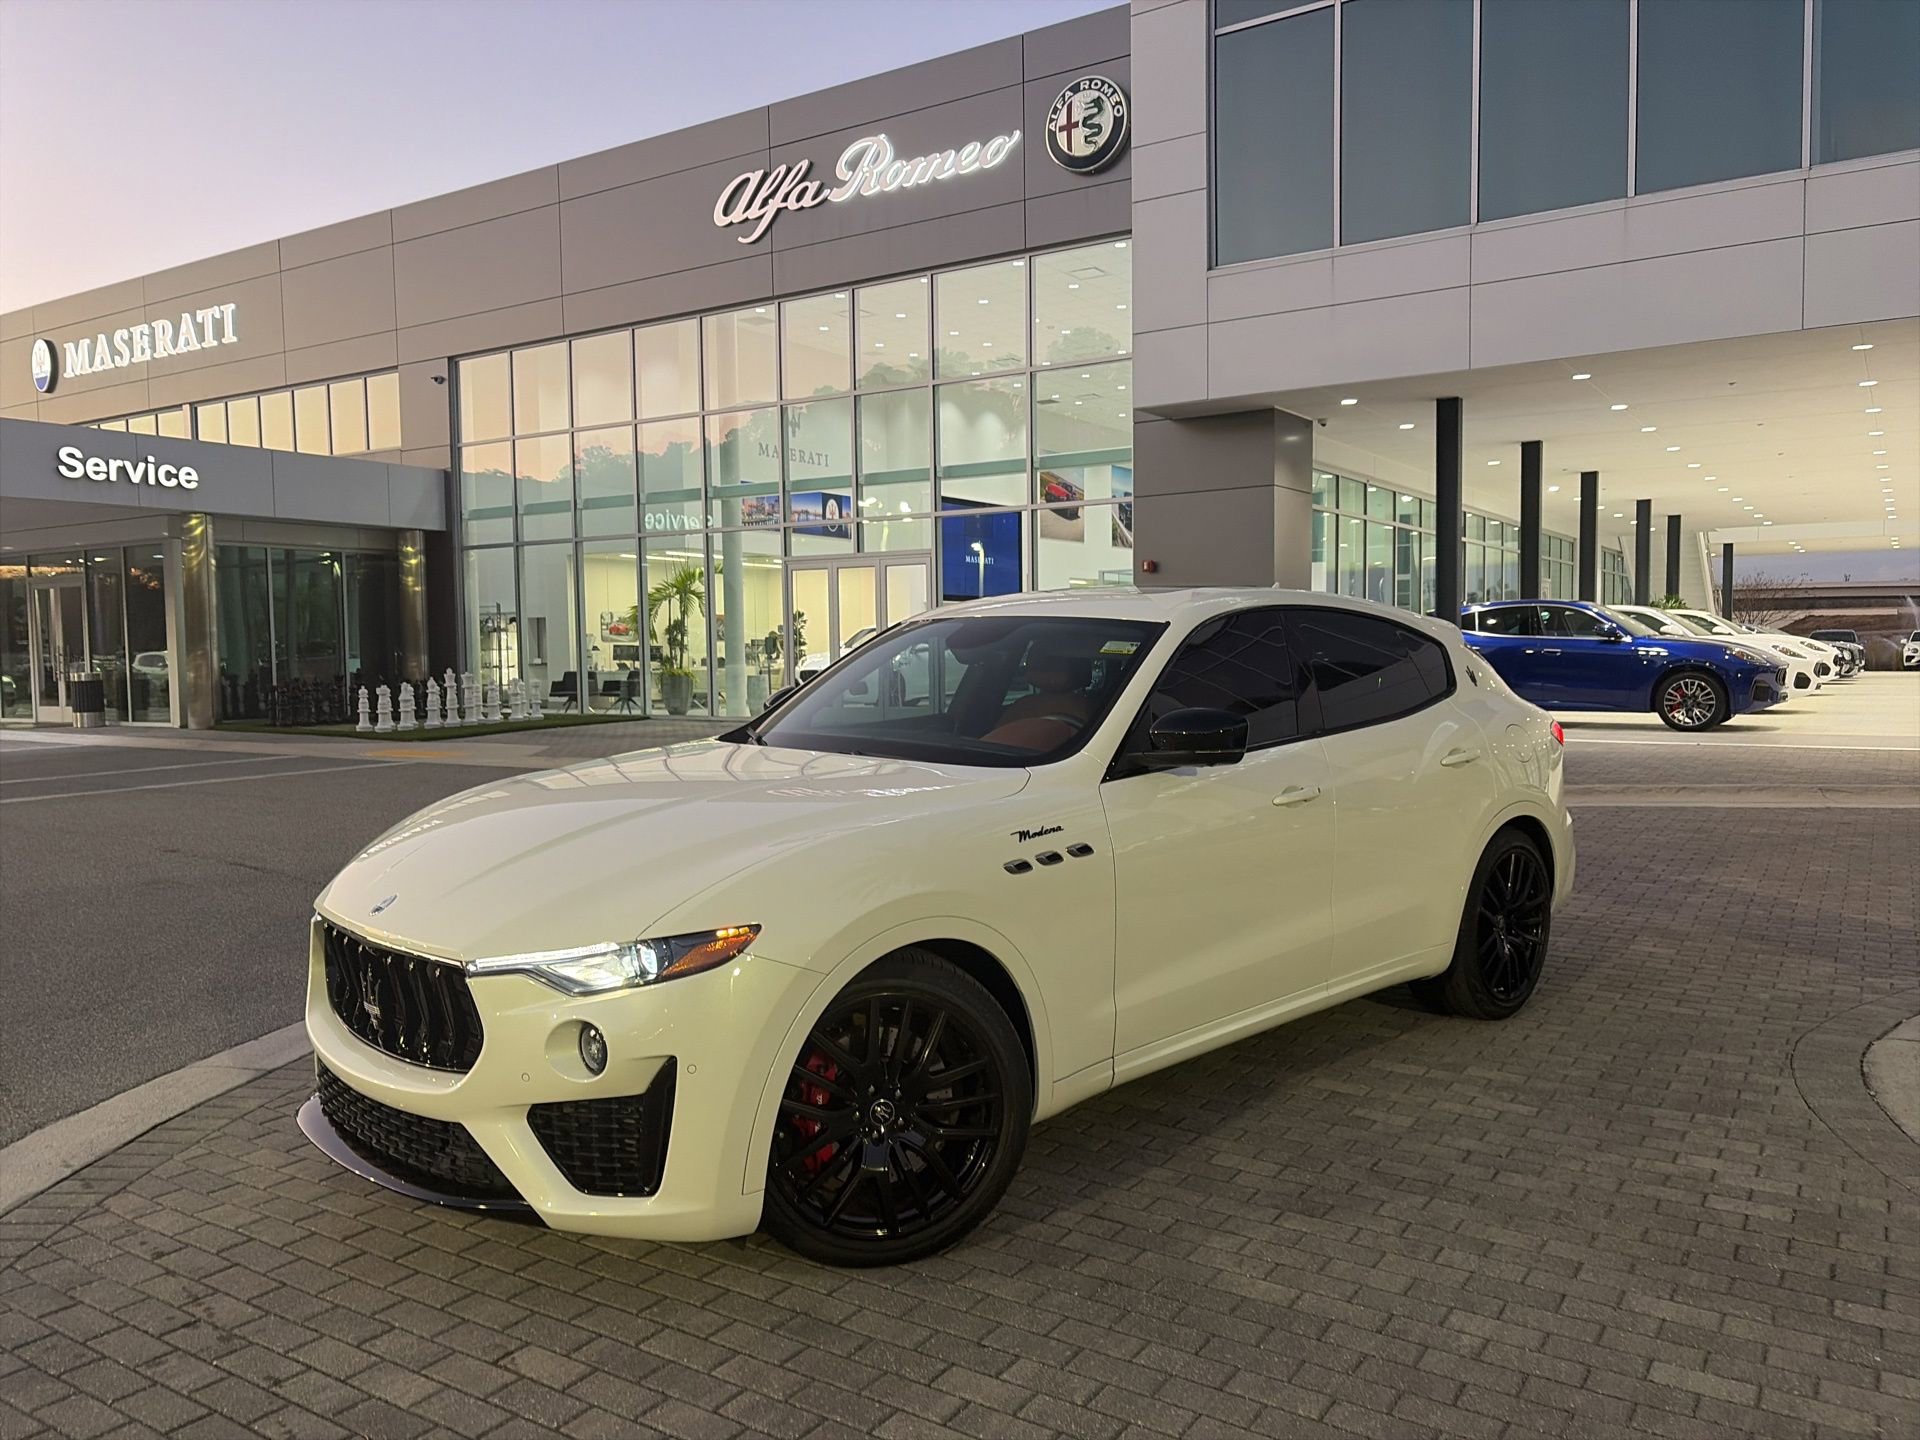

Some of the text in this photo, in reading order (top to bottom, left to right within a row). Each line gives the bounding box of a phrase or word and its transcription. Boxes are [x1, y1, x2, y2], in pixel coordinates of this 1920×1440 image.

[1049, 80, 1123, 131] ALFA ROMEO
[713, 129, 1022, 244] Alfa Romeo
[63, 303, 238, 378] MASERATI
[58, 446, 199, 489] Service
[758, 441, 830, 467] MAERATI
[965, 555, 994, 565] MASATI
[1010, 825, 1064, 843] Modena
